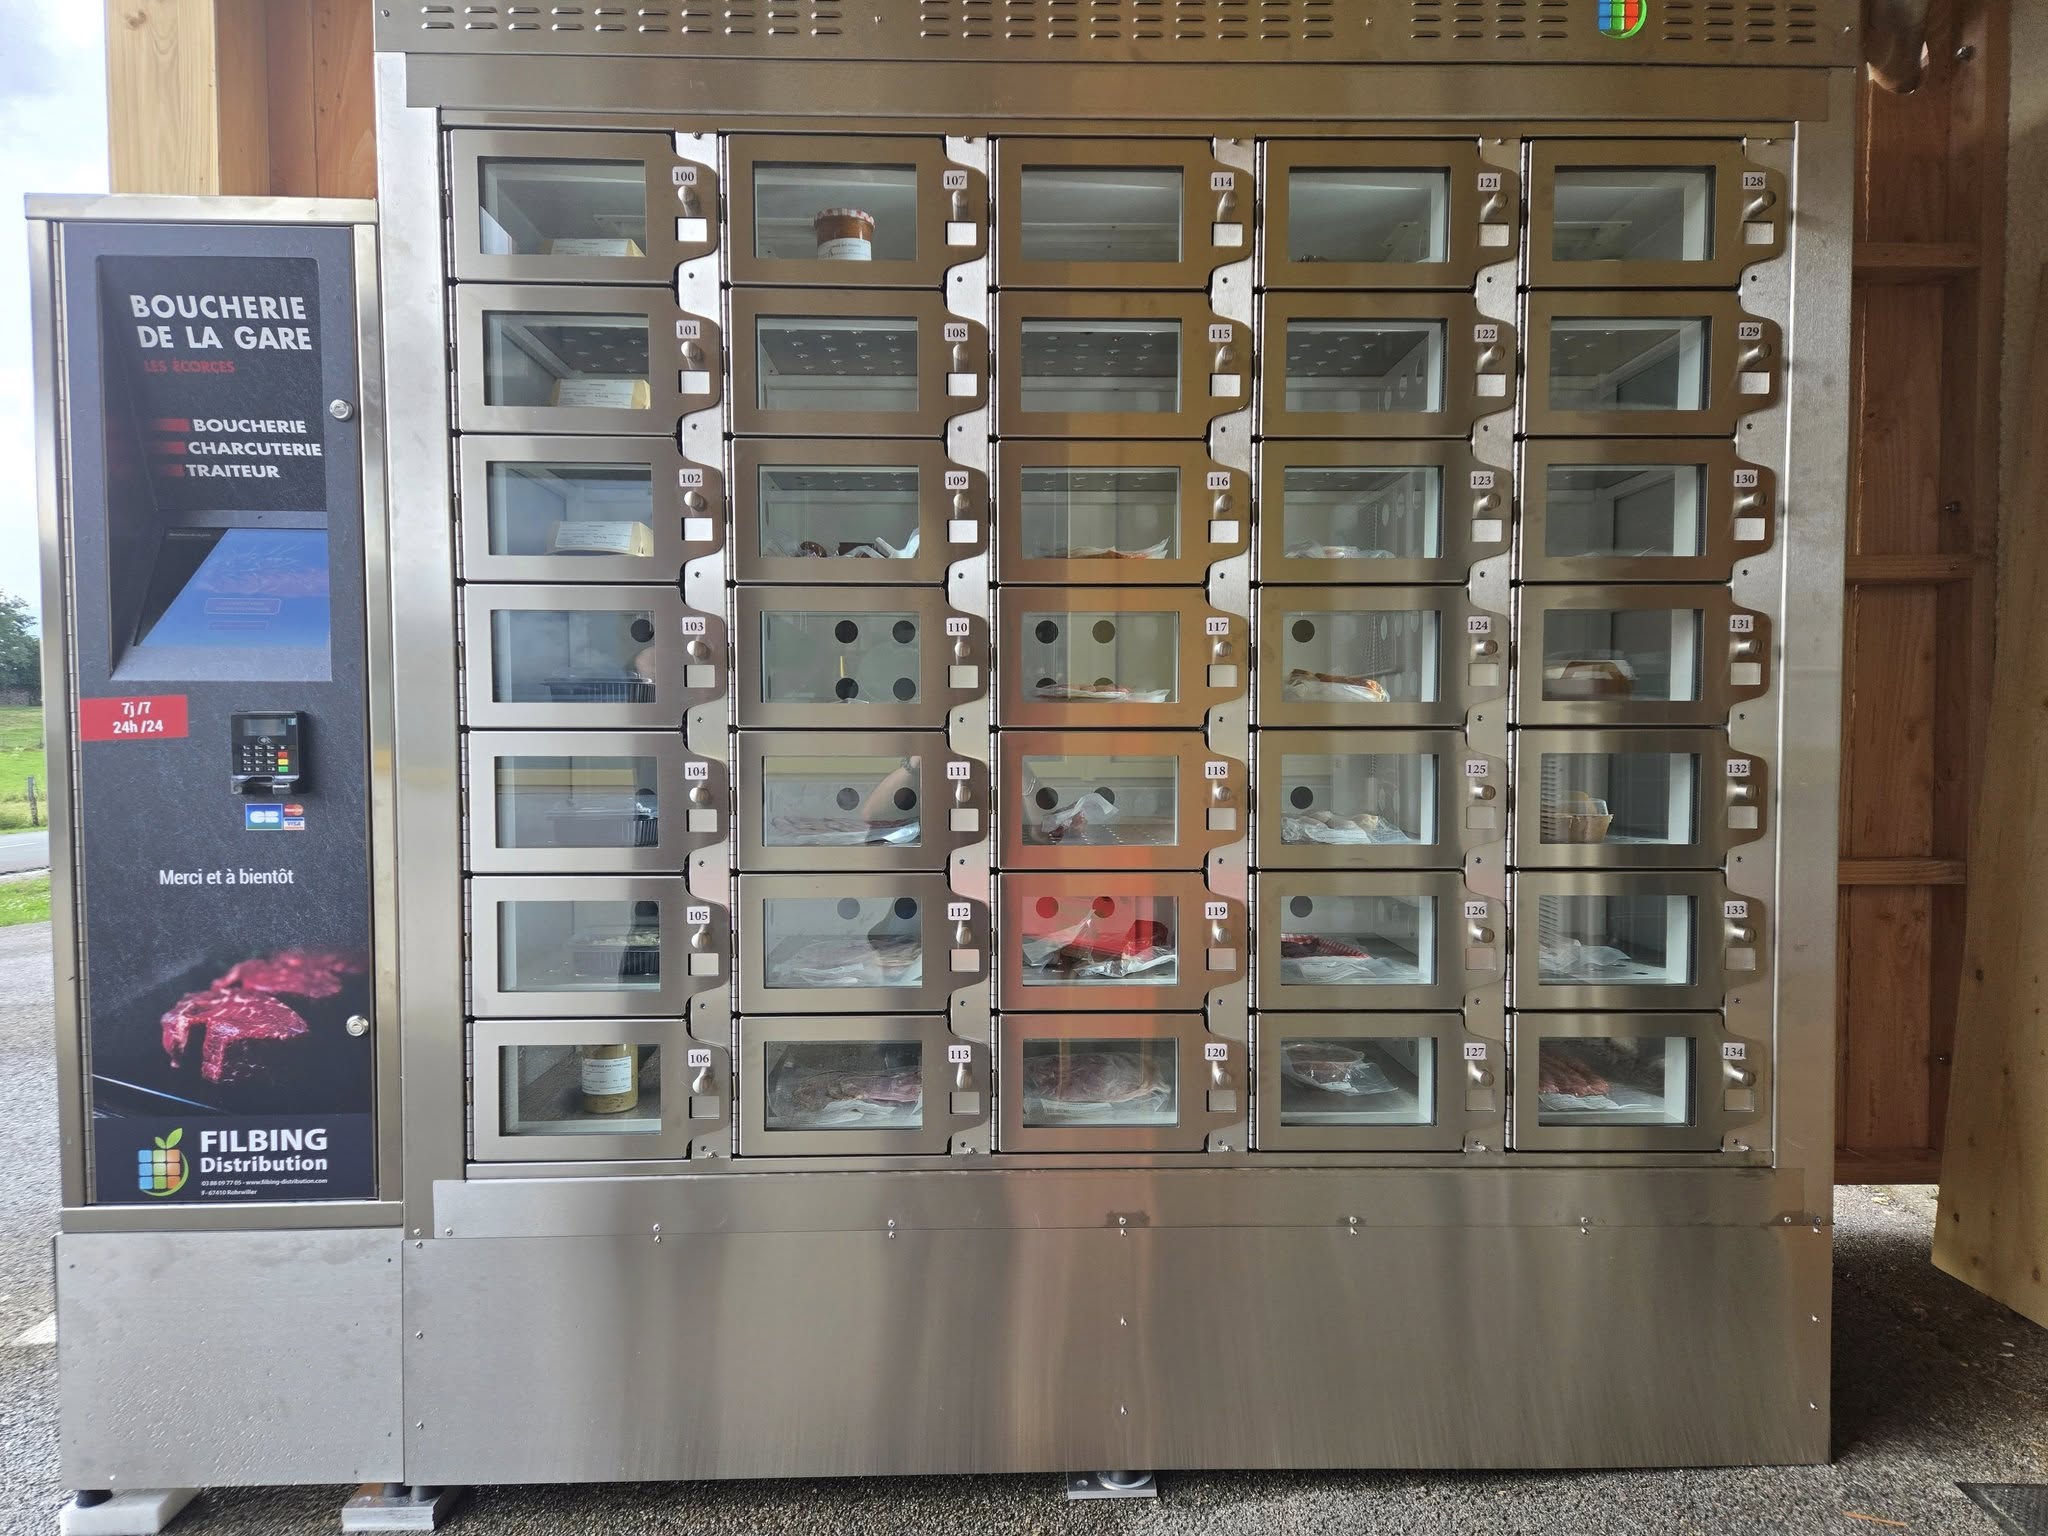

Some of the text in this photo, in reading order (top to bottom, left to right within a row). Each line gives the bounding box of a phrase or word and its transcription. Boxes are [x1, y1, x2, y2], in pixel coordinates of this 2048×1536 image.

[675, 171, 695, 182] 100
[946, 175, 965, 186] 107
[1213, 176, 1232, 188] 114
[1744, 176, 1764, 187] 128
[1479, 177, 1498, 188] 121
[129, 294, 307, 320] BOUCHERIE
[679, 325, 697, 336] 101
[947, 327, 966, 339] 108
[1211, 328, 1231, 339] 115
[1476, 328, 1496, 339] 122
[1740, 326, 1760, 337] 129
[136, 325, 313, 351] DE LA GARE
[192, 418, 308, 434] BOUCHERIE
[187, 441, 323, 457] CHARCUTERIE
[185, 463, 281, 479] TRAITEUR
[682, 473, 702, 484] 102
[948, 476, 967, 486] 109
[1210, 476, 1229, 487] 116
[1472, 475, 1492, 486] 123
[1735, 474, 1755, 484] 130
[685, 621, 704, 632] 103
[949, 622, 968, 633] 110
[1208, 621, 1228, 632] 117
[1469, 620, 1489, 631] 124
[1731, 619, 1750, 629] 131
[121, 701, 135, 718] 7j
[112, 720, 139, 734] 24h
[687, 766, 707, 777] 104
[949, 766, 967, 777] 111
[1207, 765, 1226, 776] 118
[1467, 764, 1487, 775] 125
[1728, 763, 1747, 774] 132
[159, 868, 295, 885] Merci et à bientôt
[951, 907, 969, 917] 112
[1208, 906, 1227, 916] 119
[1466, 905, 1486, 916] 126
[1726, 905, 1745, 915] 133
[689, 911, 709, 921] 105
[951, 1049, 970, 1060] 113
[1207, 1047, 1226, 1058] 120
[1465, 1047, 1485, 1057] 127
[1724, 1047, 1744, 1057] 134
[690, 1054, 710, 1064] 106
[200, 1128, 328, 1153] FILBING
[200, 1155, 328, 1173] Distribution
